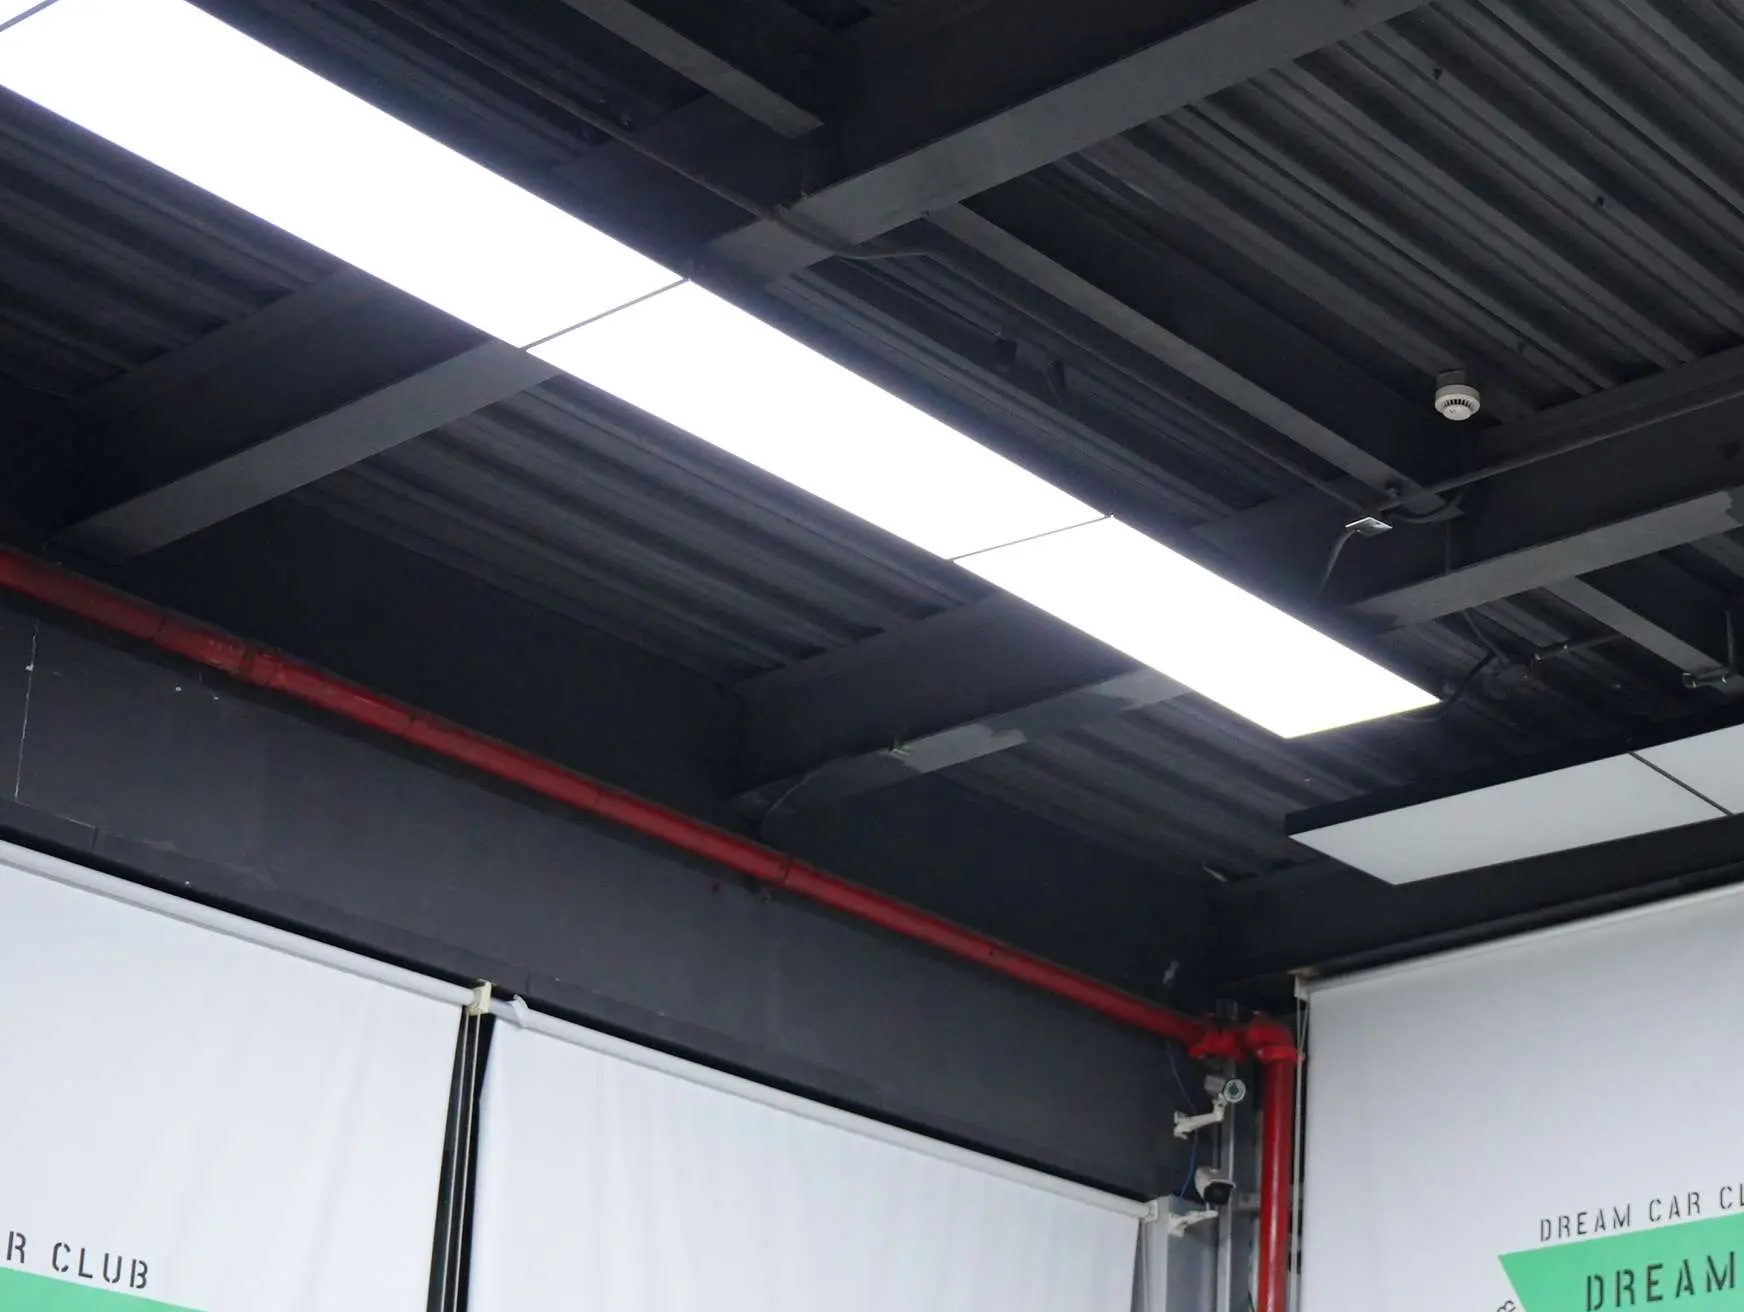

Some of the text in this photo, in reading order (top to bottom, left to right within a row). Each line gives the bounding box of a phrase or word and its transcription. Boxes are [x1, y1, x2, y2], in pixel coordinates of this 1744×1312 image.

[1540, 1203, 1632, 1242] DREAM
[1649, 1191, 1701, 1223] CAR
[52, 1242, 149, 1290] CLUB
[1586, 1251, 1736, 1312] DREAM
